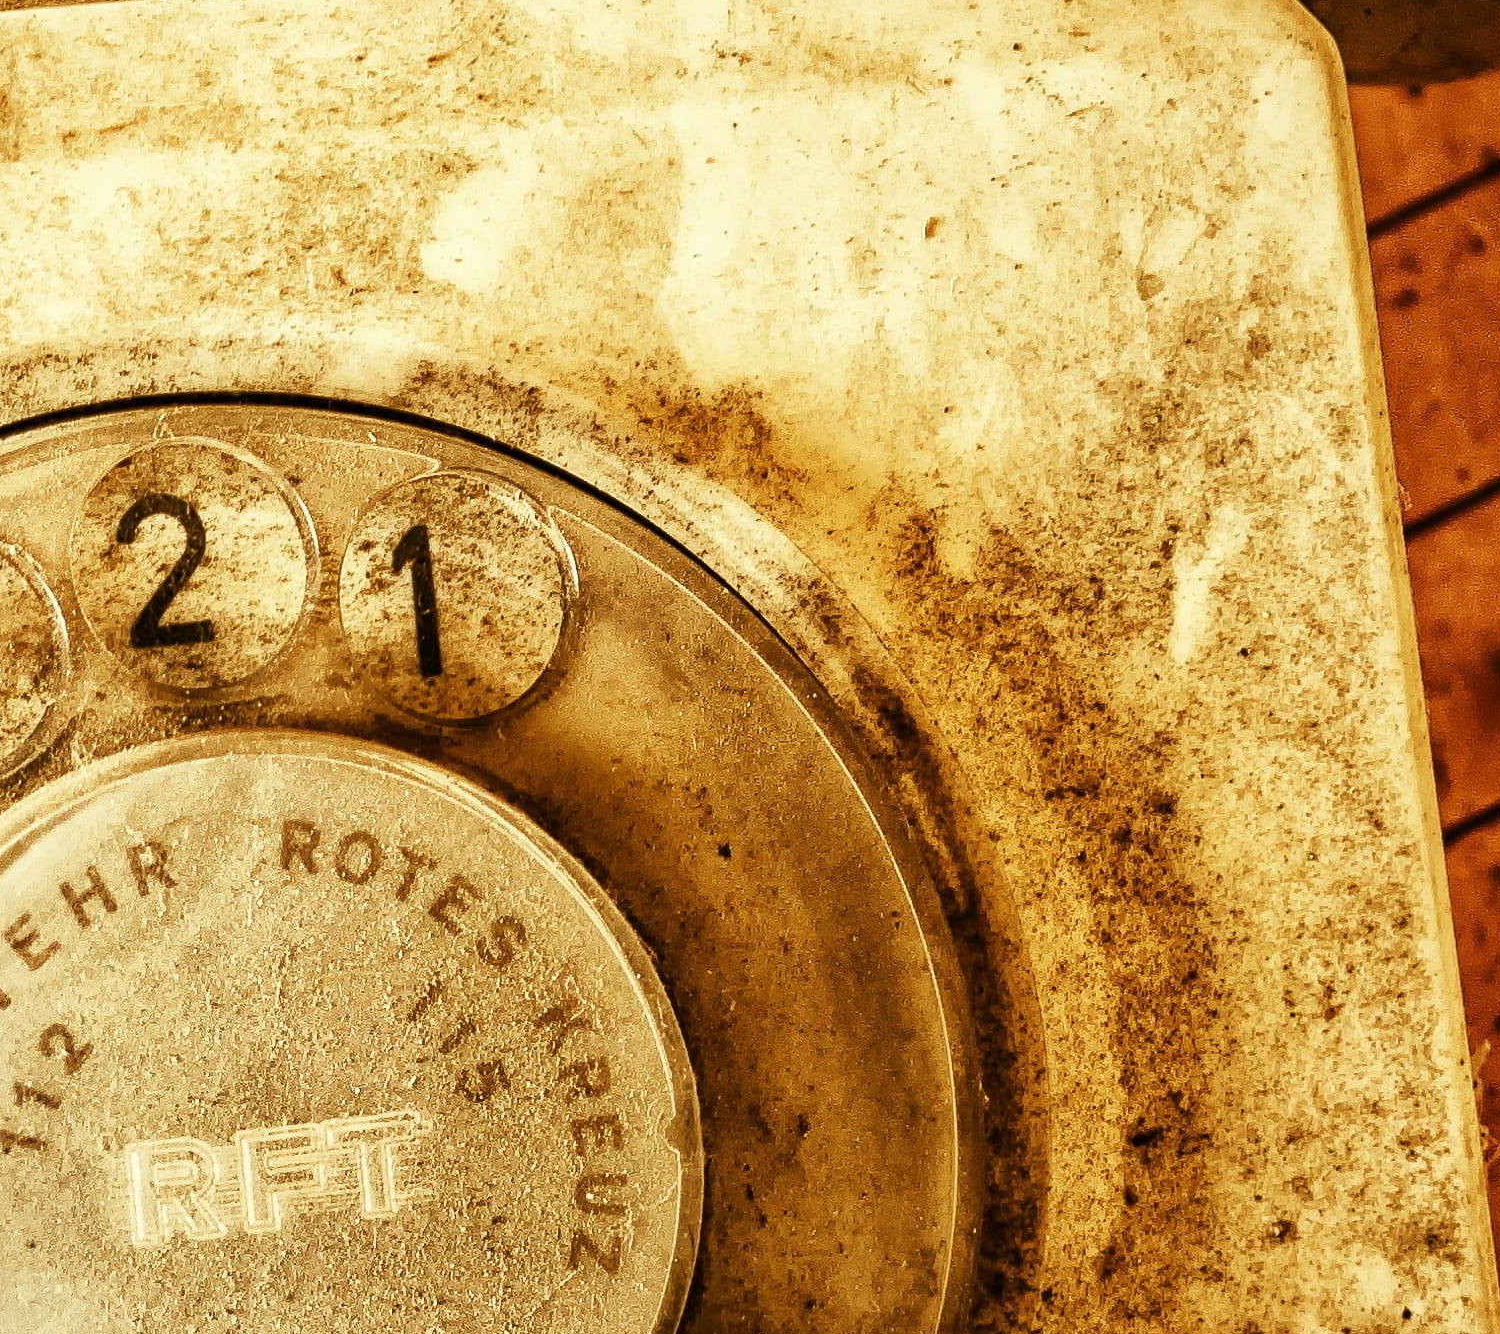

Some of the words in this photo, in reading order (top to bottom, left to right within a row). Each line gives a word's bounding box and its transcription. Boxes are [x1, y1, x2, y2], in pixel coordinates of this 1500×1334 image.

[115, 492, 216, 650] 2
[388, 522, 445, 677] 1
[0, 1021, 94, 1155] 112
[279, 818, 529, 971] ROTES
[533, 995, 623, 1273] KREUZ
[123, 1109, 434, 1251] RFT
